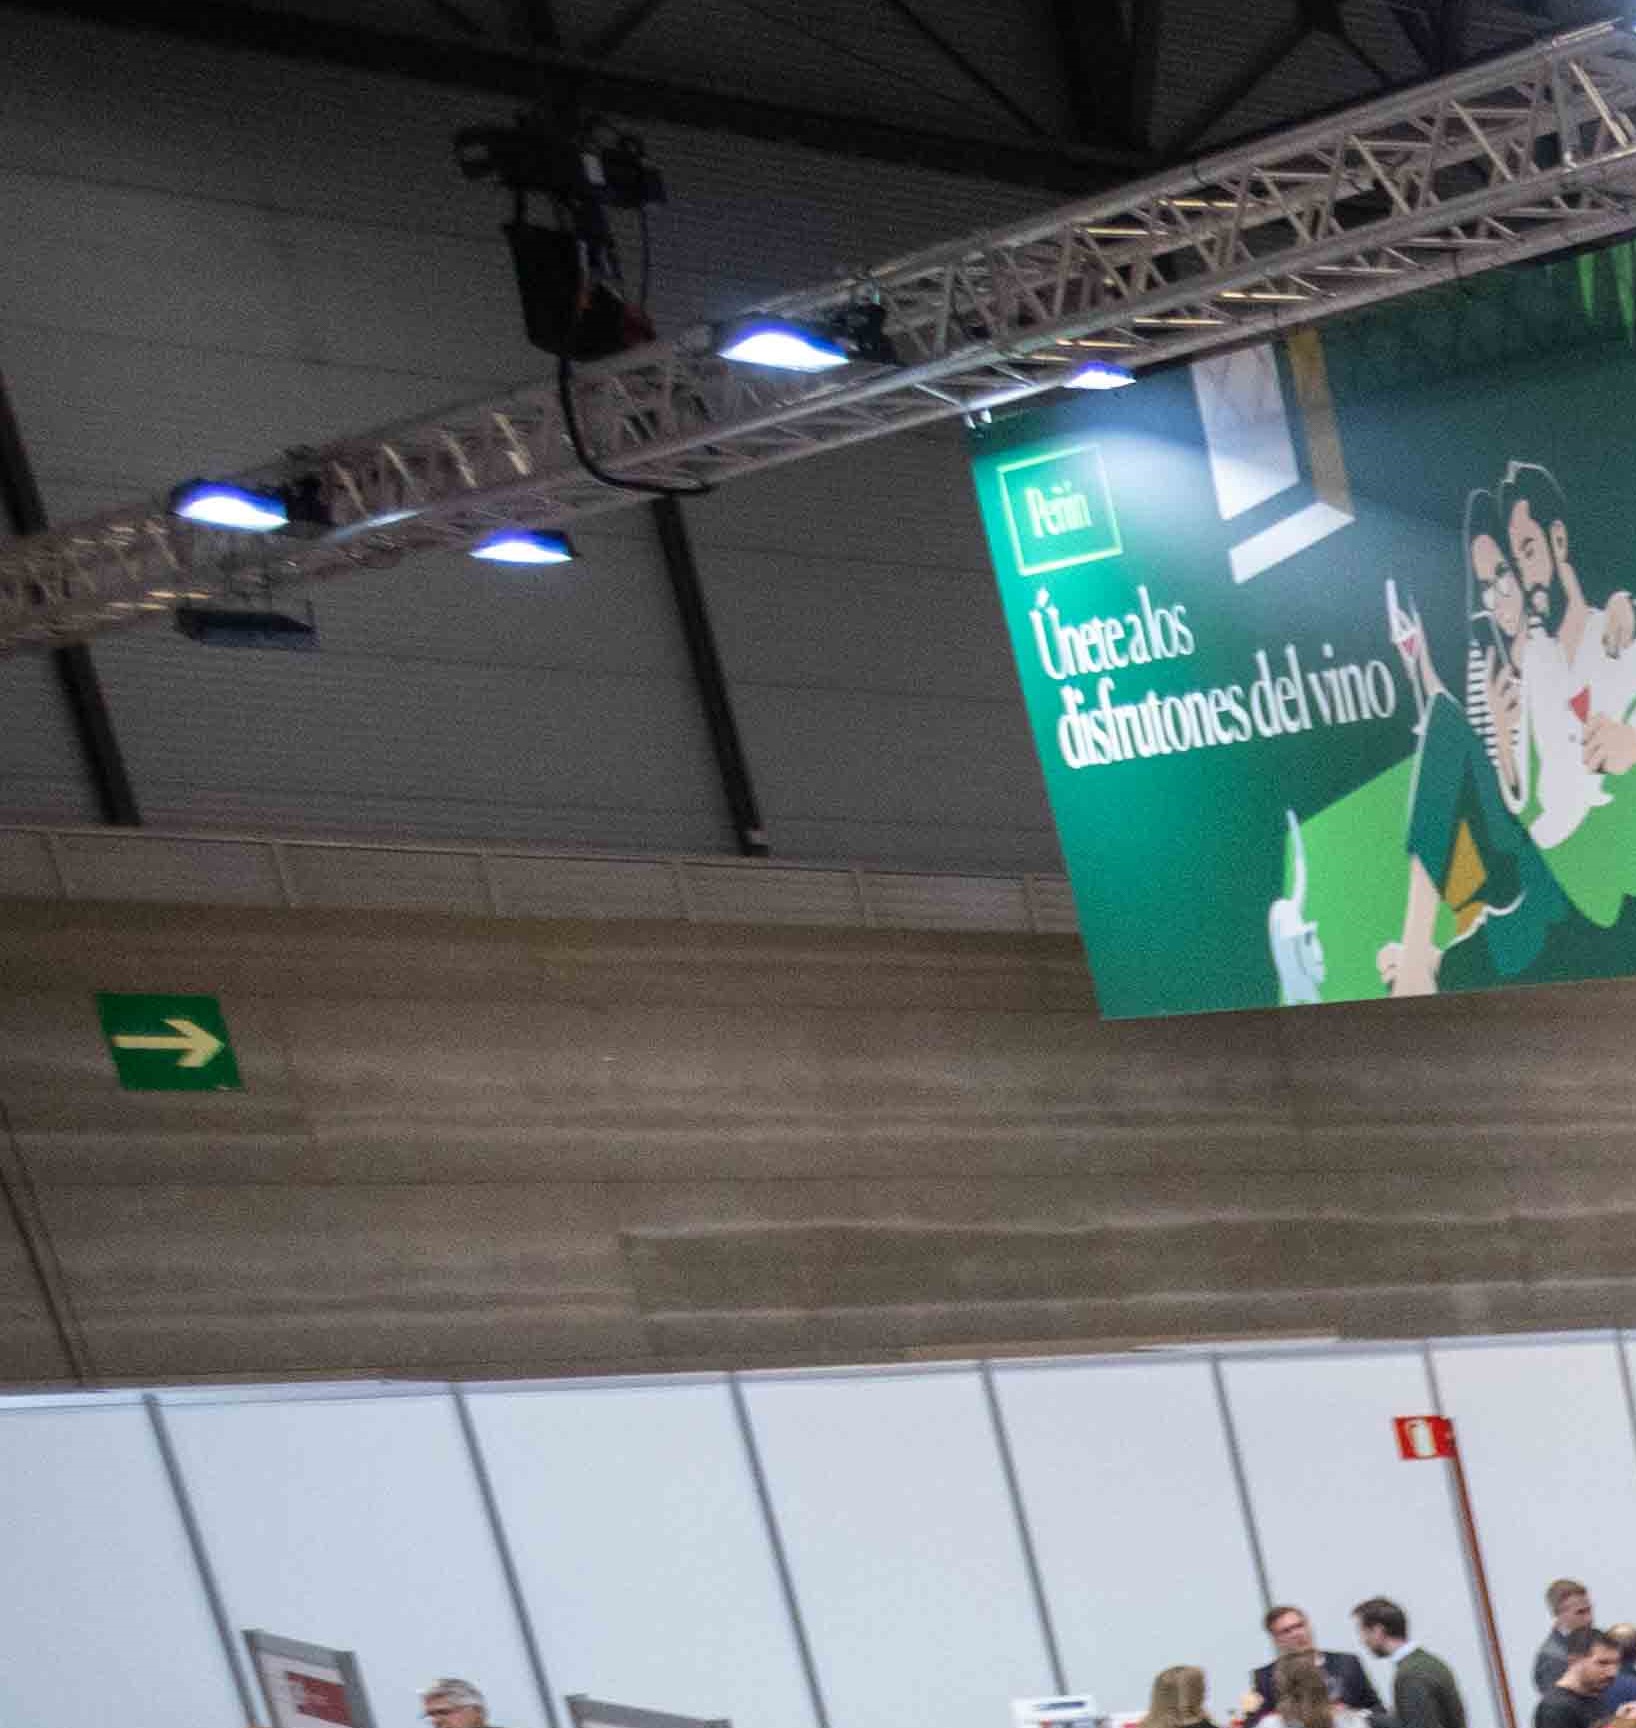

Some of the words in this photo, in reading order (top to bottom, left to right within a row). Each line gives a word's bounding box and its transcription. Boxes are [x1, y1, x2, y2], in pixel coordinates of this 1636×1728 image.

[1024, 481, 1093, 539] Peñín
[1029, 588, 1128, 680] Únete
[1124, 613, 1152, 665] a
[1137, 585, 1194, 662] los
[1058, 677, 1252, 769] disfrutones
[1251, 644, 1312, 737] del
[1307, 643, 1396, 725] vino
